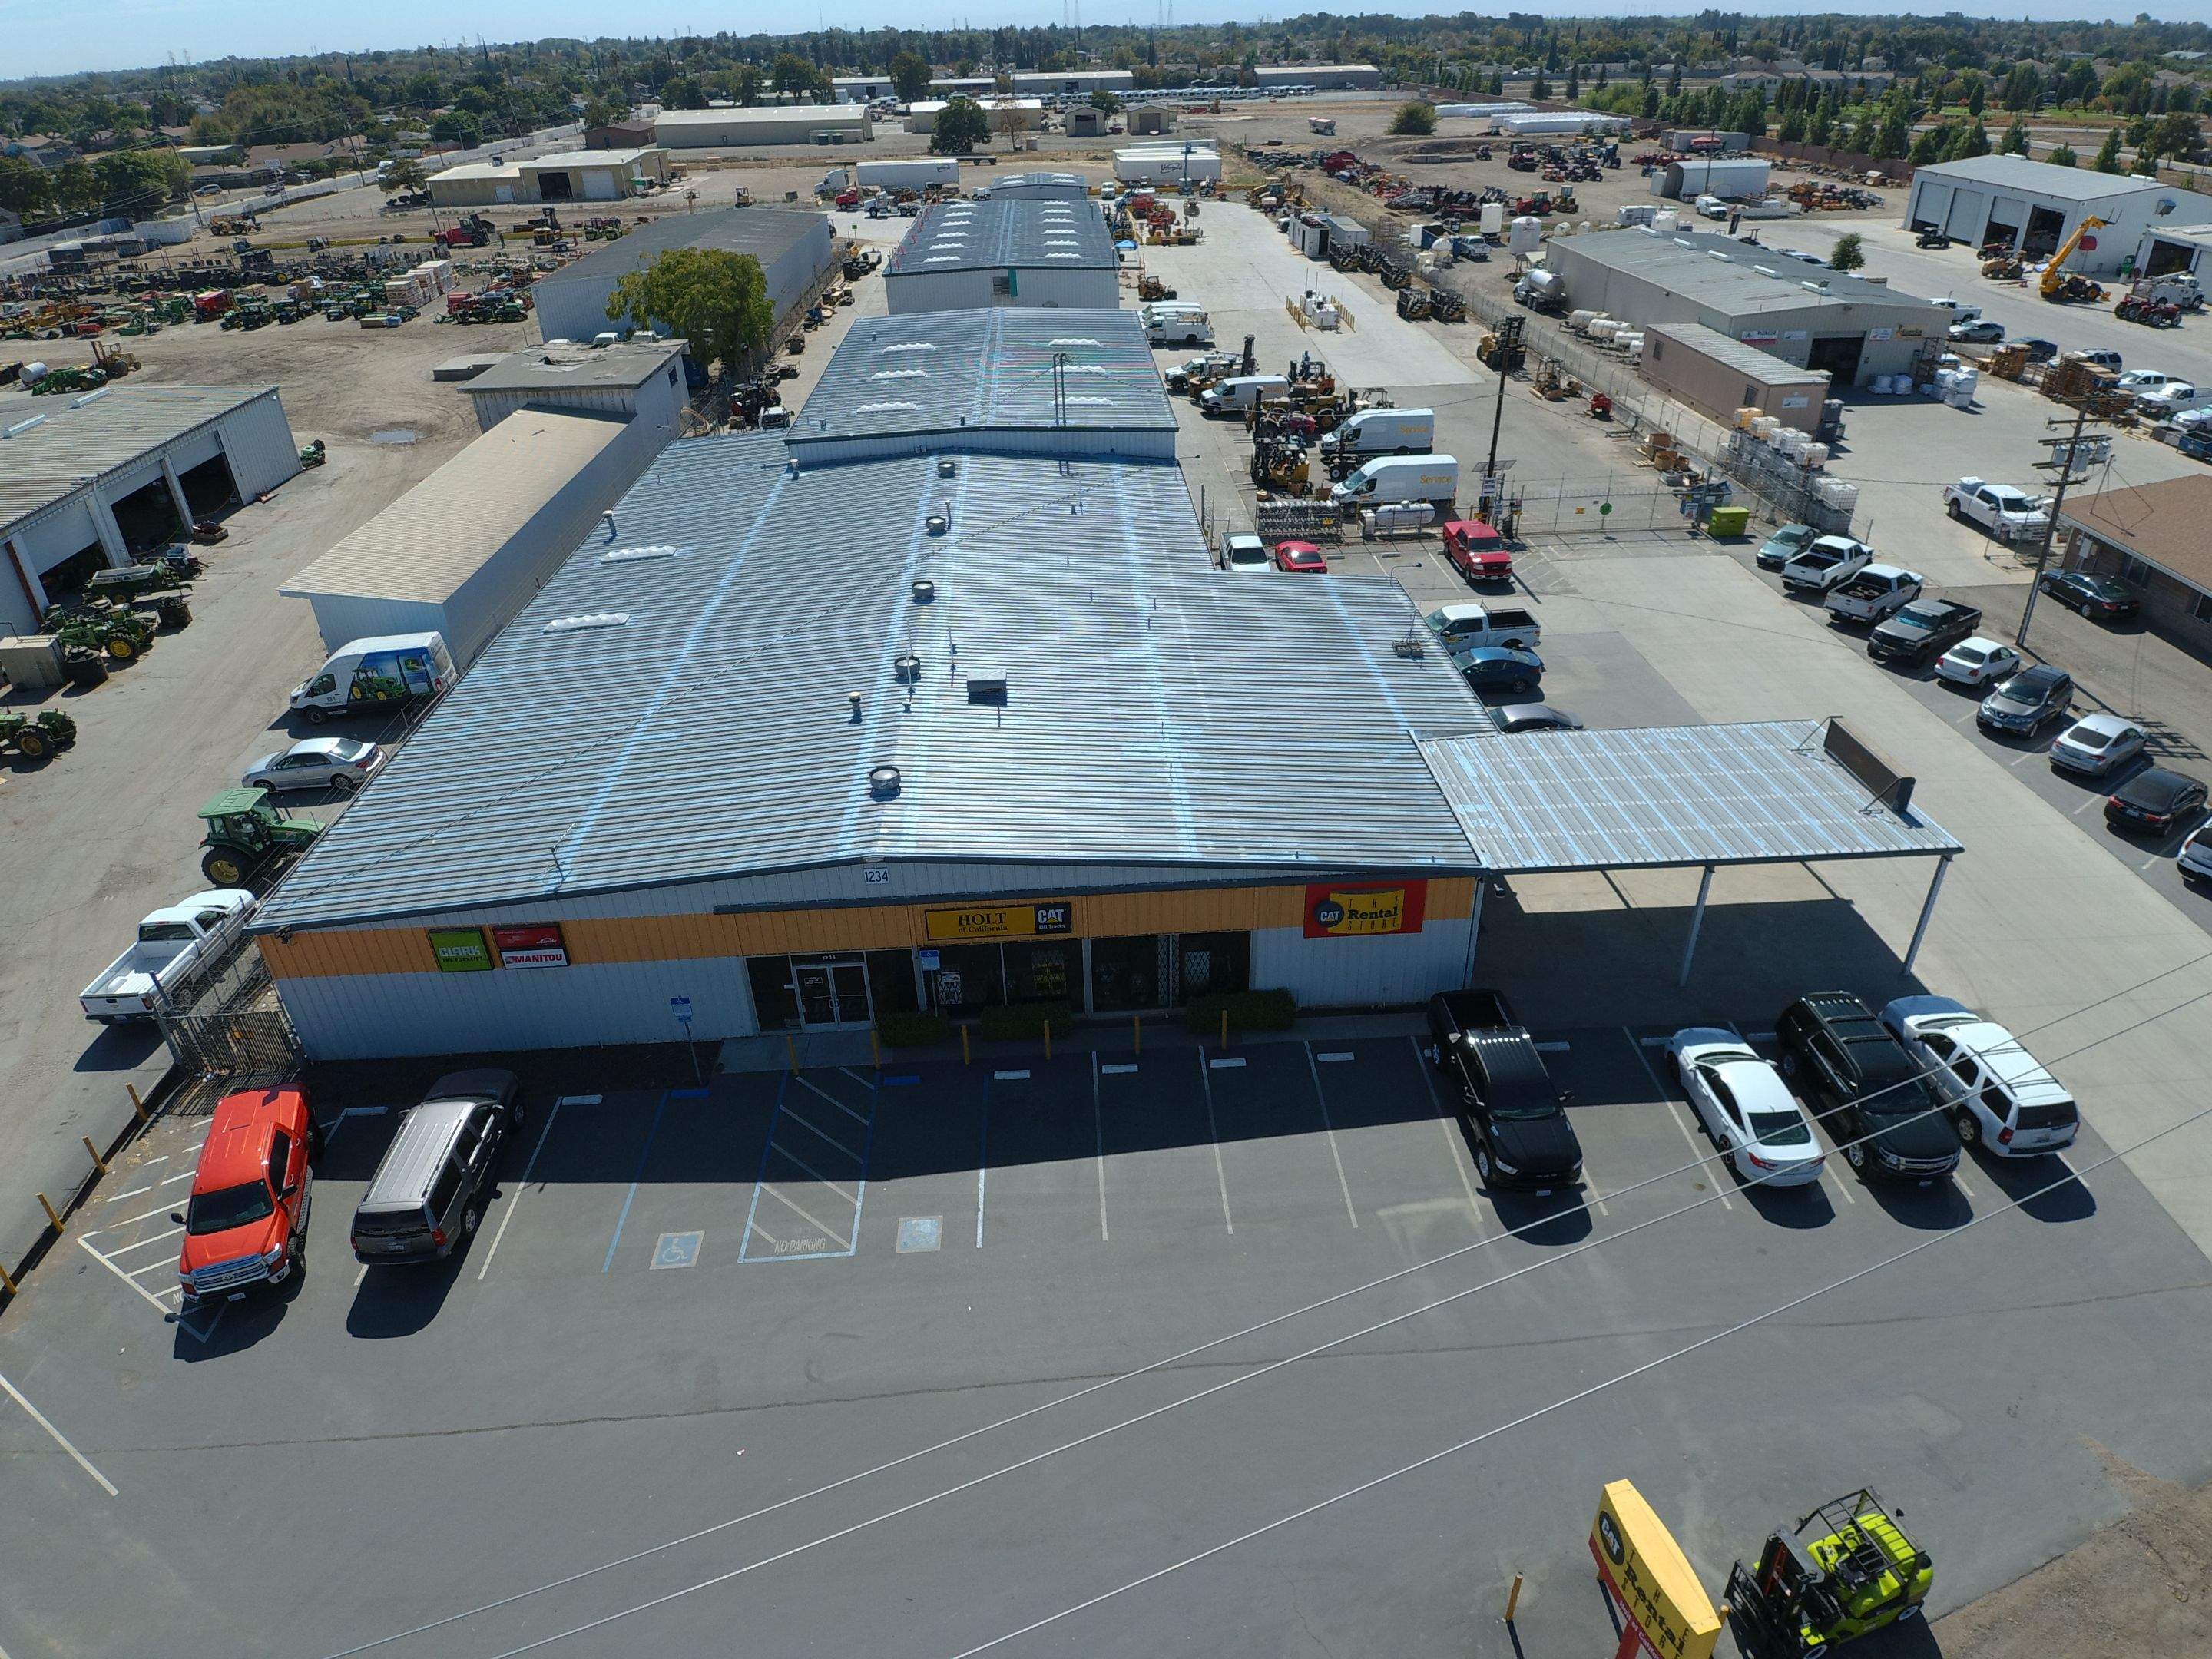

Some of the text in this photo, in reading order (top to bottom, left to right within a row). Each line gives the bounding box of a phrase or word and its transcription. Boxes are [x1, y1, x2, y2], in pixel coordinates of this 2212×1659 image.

[1400, 425, 1429, 434] Service
[1420, 474, 1452, 485] Service
[864, 870, 889, 882] 1234
[1037, 909, 1065, 923] CAT
[1320, 910, 1340, 922] CAT
[1348, 906, 1399, 919] Rental
[958, 912, 1007, 926] HOLT
[1348, 918, 1396, 931] STORE
[968, 925, 1008, 933] California
[439, 945, 480, 957] CLARK
[515, 954, 563, 963] MANITOU
[774, 1238, 826, 1253] NO PARKING
[1601, 1518, 1621, 1555] CAT
[1624, 1561, 1685, 1656] Rental
